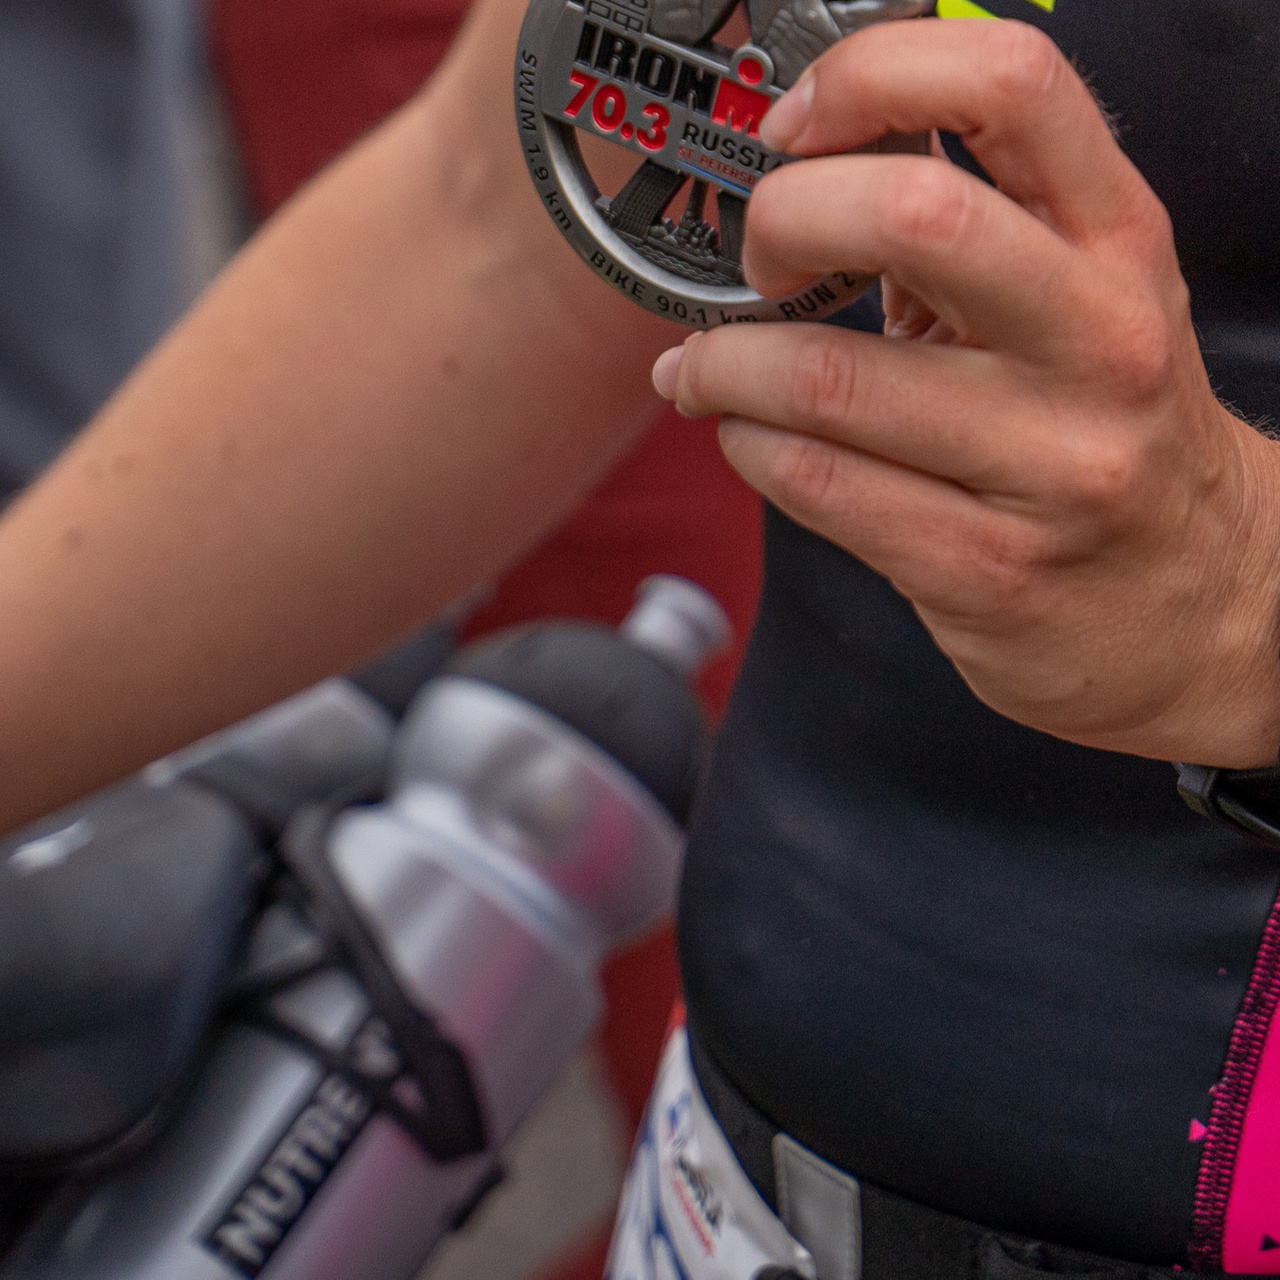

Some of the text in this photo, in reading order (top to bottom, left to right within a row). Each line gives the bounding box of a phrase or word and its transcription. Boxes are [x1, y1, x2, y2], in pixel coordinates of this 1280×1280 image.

[586, 0, 645, 33] РФ
[563, 69, 672, 152] 70.3
[574, 19, 771, 139] IRONM
[519, 49, 573, 230] SWIM 1.9 km
[699, 153, 757, 186] PETERSB
[590, 250, 646, 300] BIKE
[656, 294, 708, 325] 90.1
[778, 282, 837, 320] RUN
